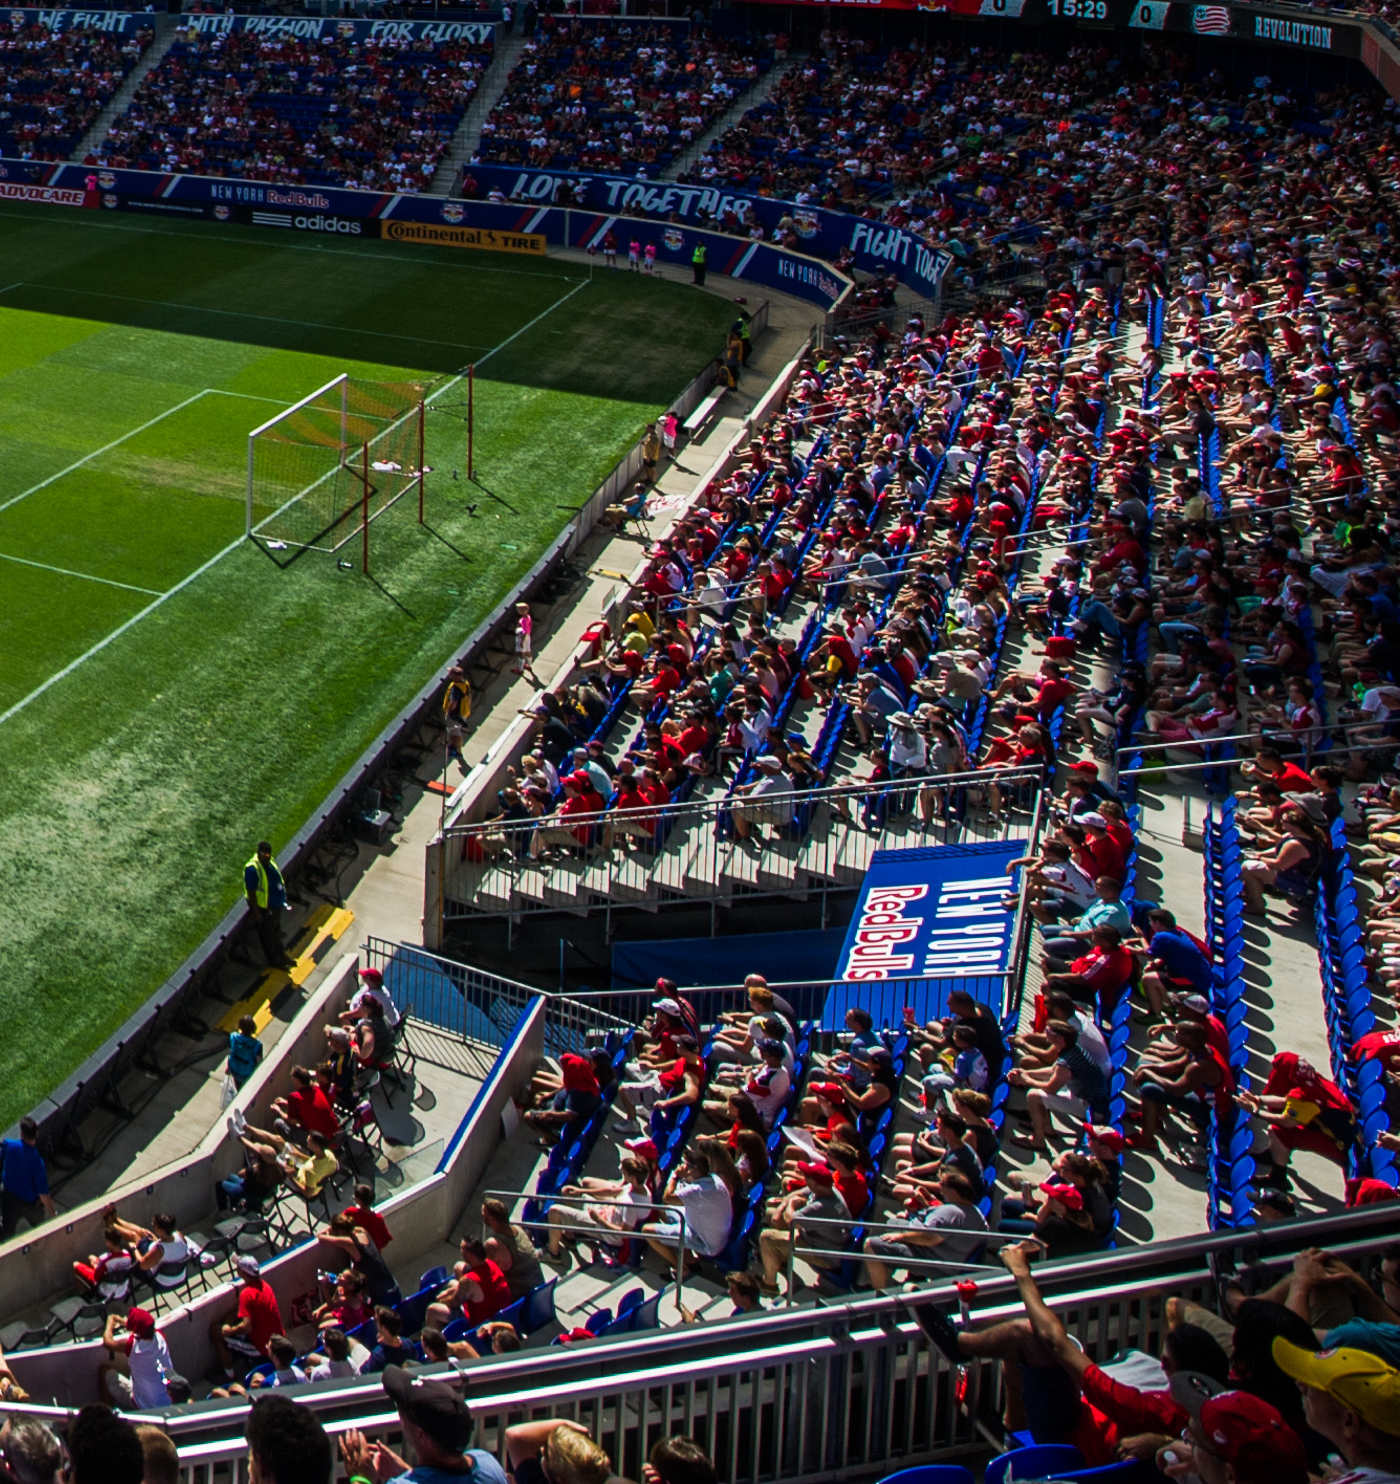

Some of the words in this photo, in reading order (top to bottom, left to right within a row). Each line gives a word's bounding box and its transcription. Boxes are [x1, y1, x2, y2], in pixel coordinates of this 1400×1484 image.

[38, 11, 67, 30] WE
[71, 12, 133, 33] FIGHT
[1140, 5, 1151, 23] 0
[187, 15, 234, 34] WITH
[245, 17, 325, 39] PASSION
[370, 21, 415, 42] FOR
[420, 23, 492, 44] GLORY
[1254, 16, 1333, 50] REVOLUTION
[210, 185, 233, 200] NEW
[236, 187, 264, 202] YORK
[295, 215, 362, 234] adidas
[387, 220, 481, 245] Continental
[501, 236, 541, 251] TIRE
[850, 222, 913, 266] FIGHT
[778, 259, 795, 279] NEW
[797, 265, 818, 284] YORK
[935, 876, 1013, 918] NEW
[922, 922, 1006, 977] YORK
